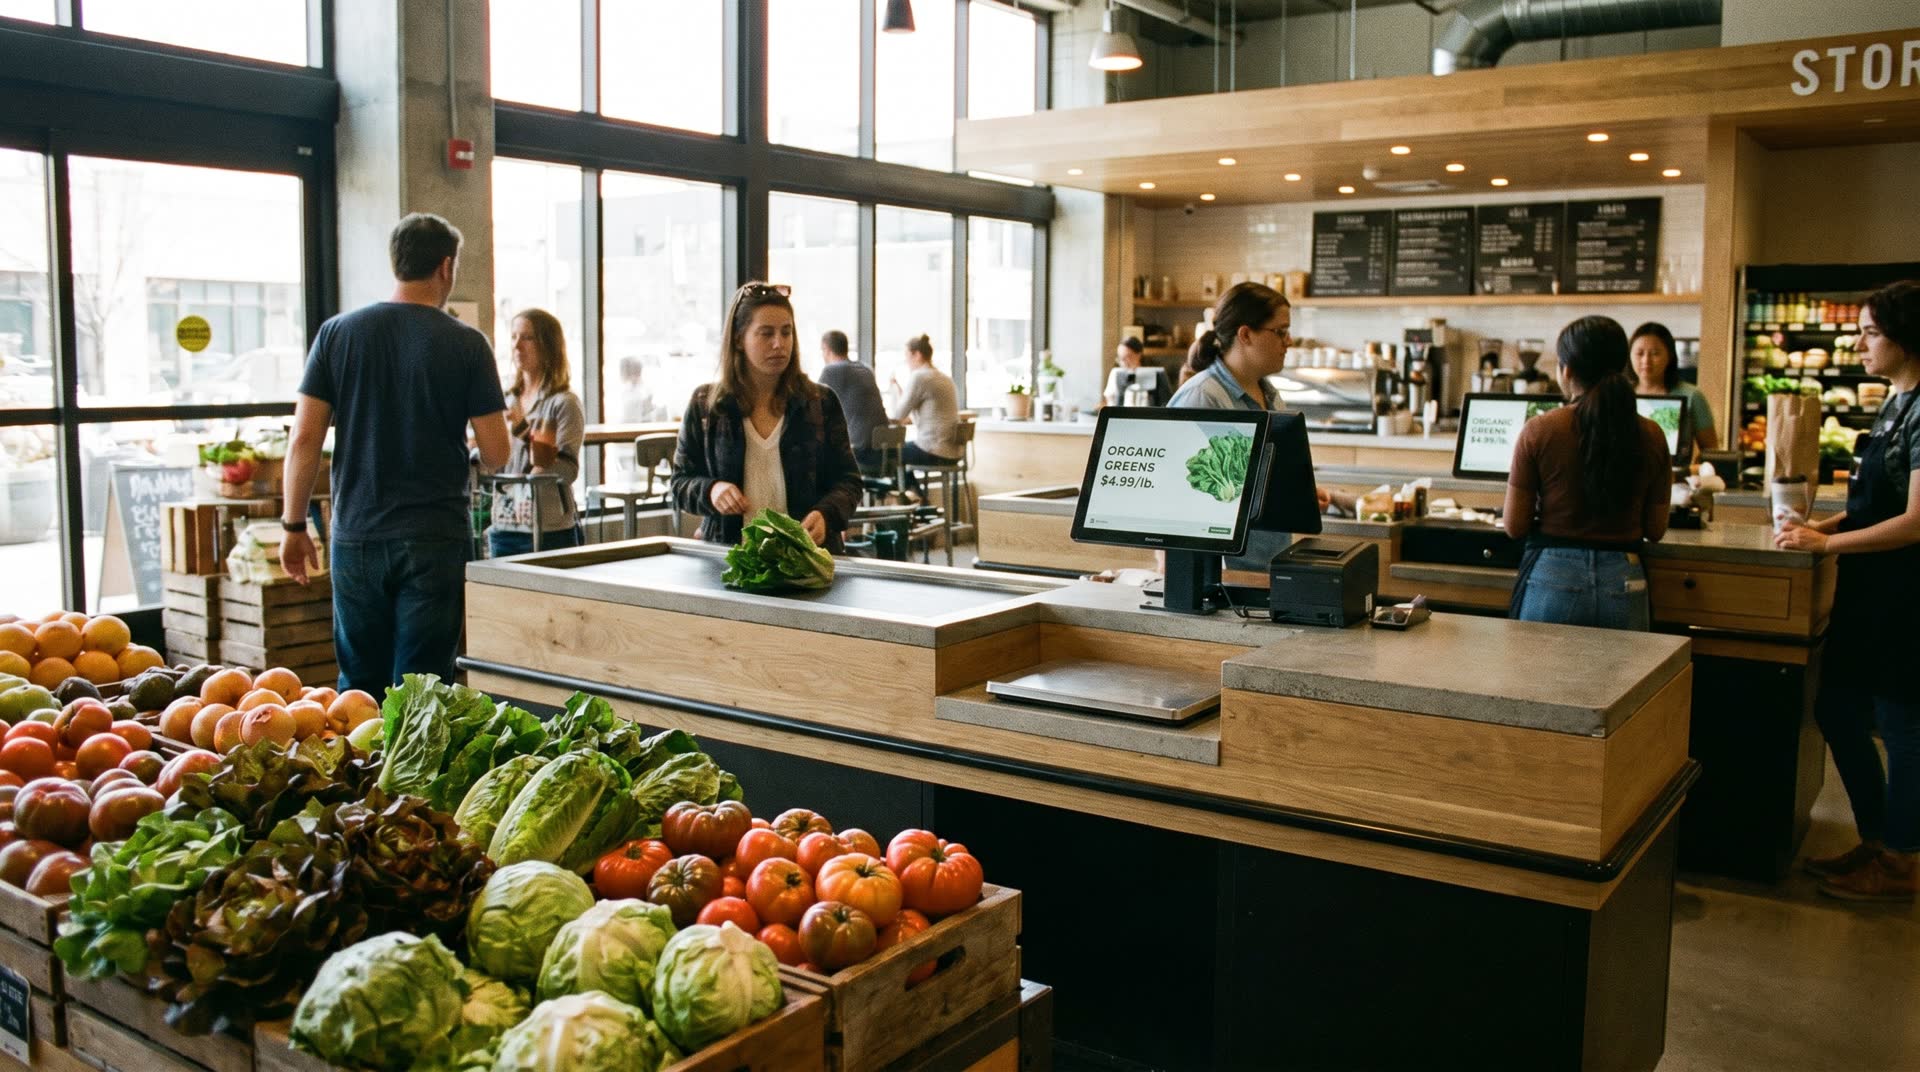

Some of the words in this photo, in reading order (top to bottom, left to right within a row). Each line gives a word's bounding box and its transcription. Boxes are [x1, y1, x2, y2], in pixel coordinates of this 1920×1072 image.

[1791, 40, 1920, 96] STOR
[1472, 417, 1513, 426] ORGANIC
[1471, 427, 1507, 435] GREENS
[1107, 446, 1166, 458] ORGANIC
[1104, 460, 1155, 472] GREENS
[1100, 475, 1155, 488] $4.99/lb.
